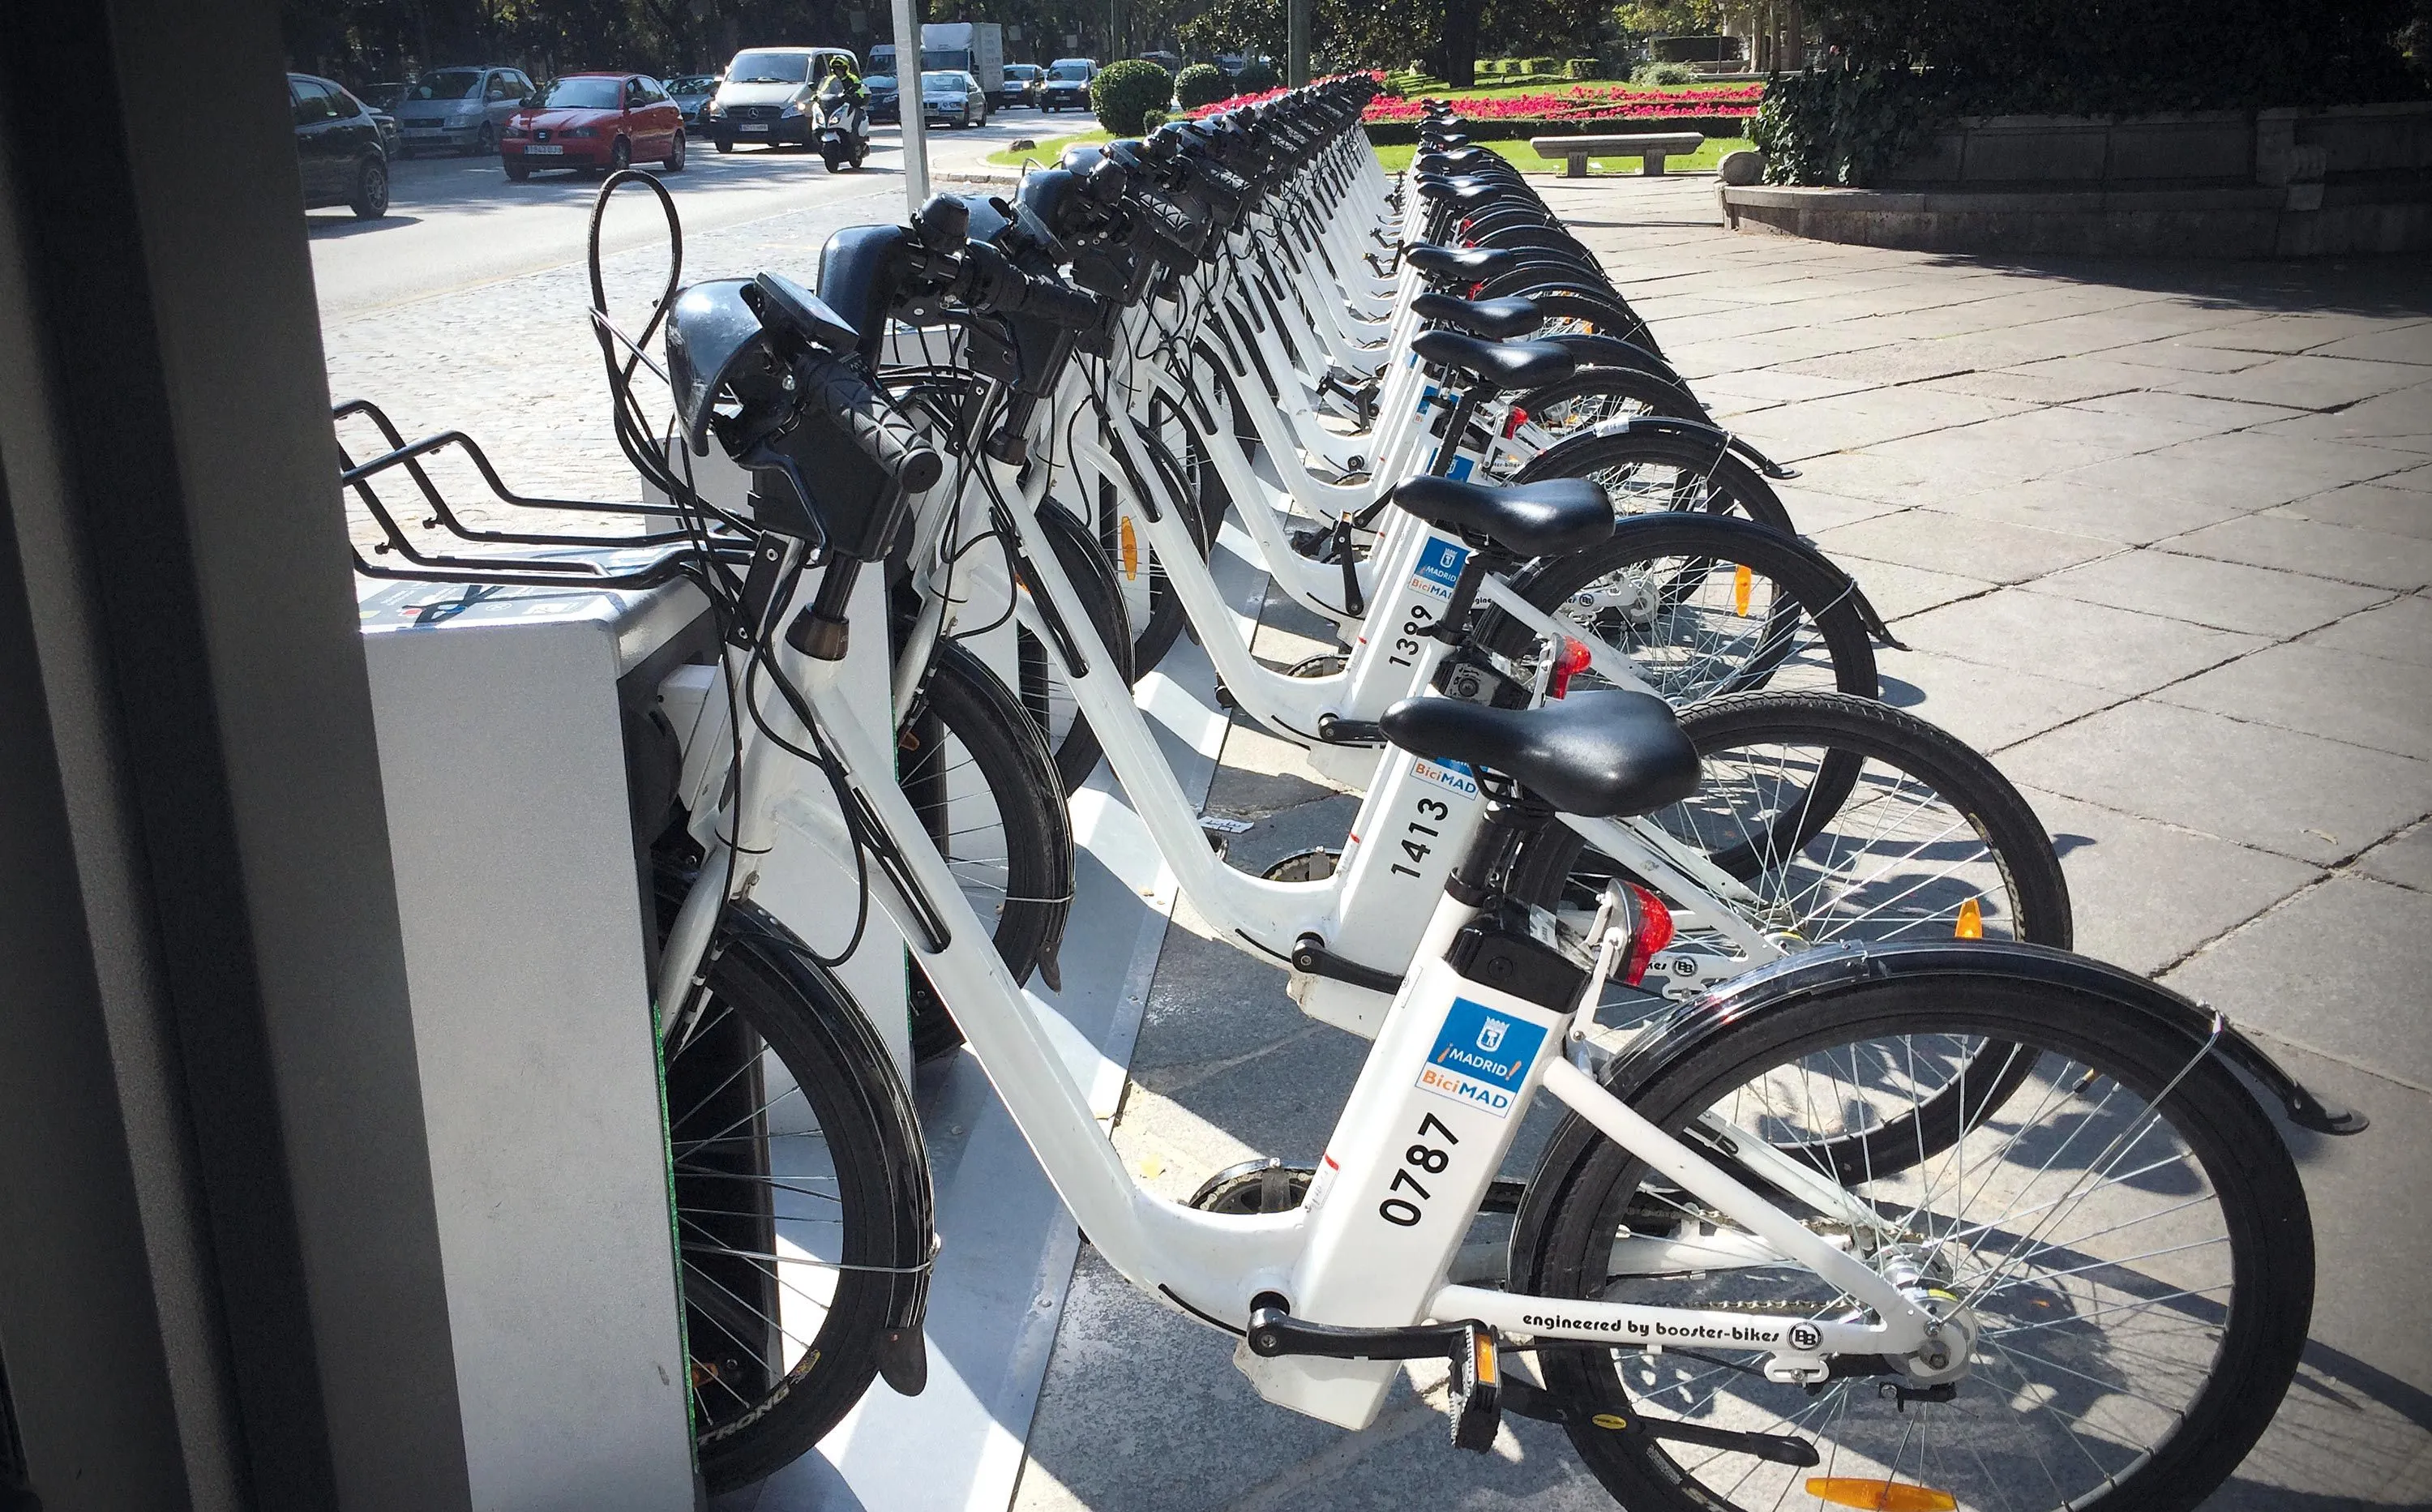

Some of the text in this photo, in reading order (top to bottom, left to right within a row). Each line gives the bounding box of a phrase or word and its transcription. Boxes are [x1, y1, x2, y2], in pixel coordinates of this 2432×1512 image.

[1415, 763, 1477, 794] BiciMAD
[1391, 798, 1449, 878] 1413
[1422, 1069, 1508, 1109] BiciMAD
[1379, 1112, 1459, 1227] 0787
[1522, 1315, 1780, 1343] engineered by booster-bikes
